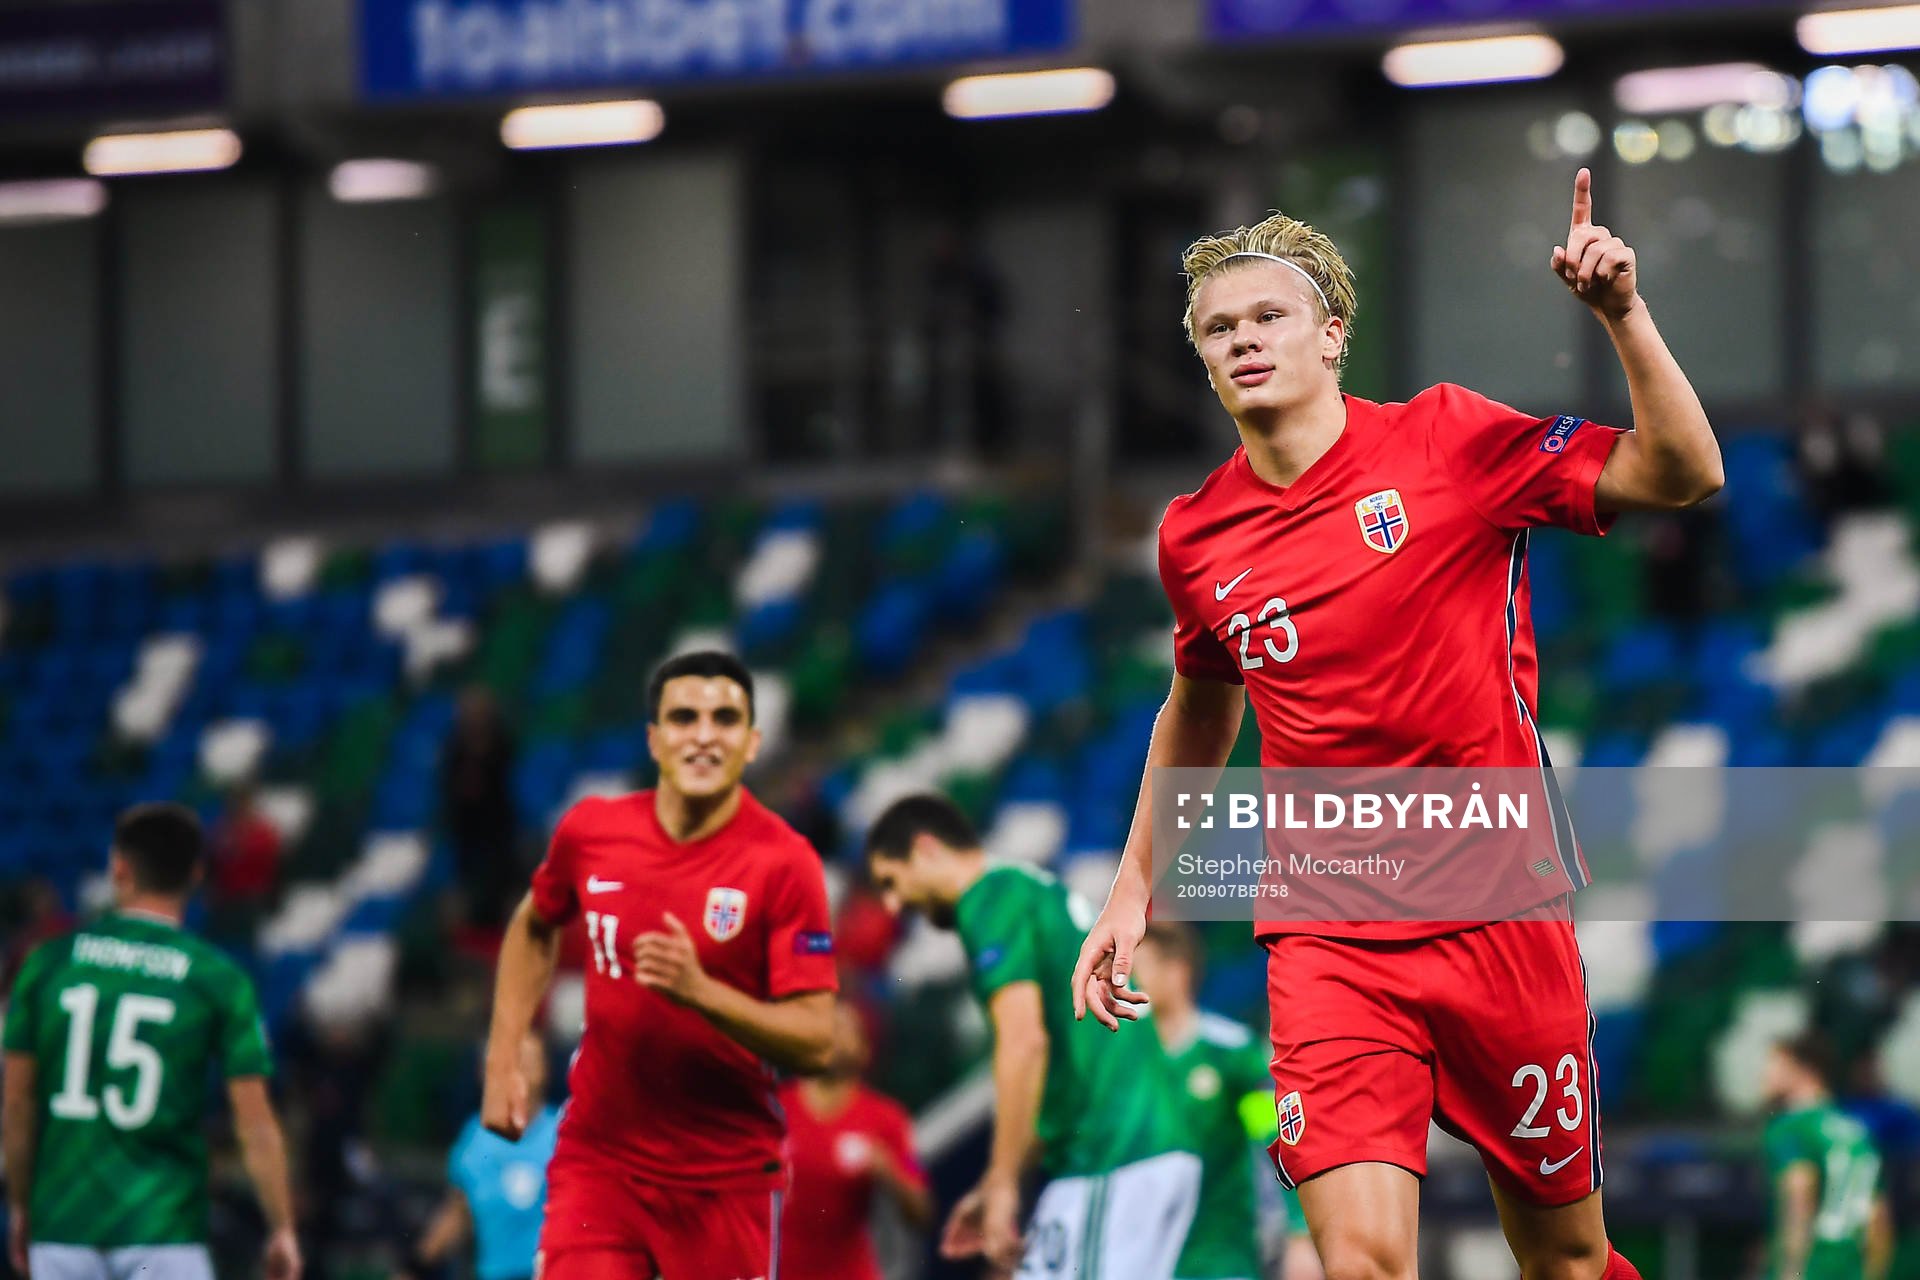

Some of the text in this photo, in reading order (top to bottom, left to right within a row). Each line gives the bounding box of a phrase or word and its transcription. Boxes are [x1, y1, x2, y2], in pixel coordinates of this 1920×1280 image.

[1228, 597, 1299, 670] 23
[585, 911, 623, 979] 11
[50, 983, 176, 1130] 15
[1510, 1053, 1583, 1138] 23
